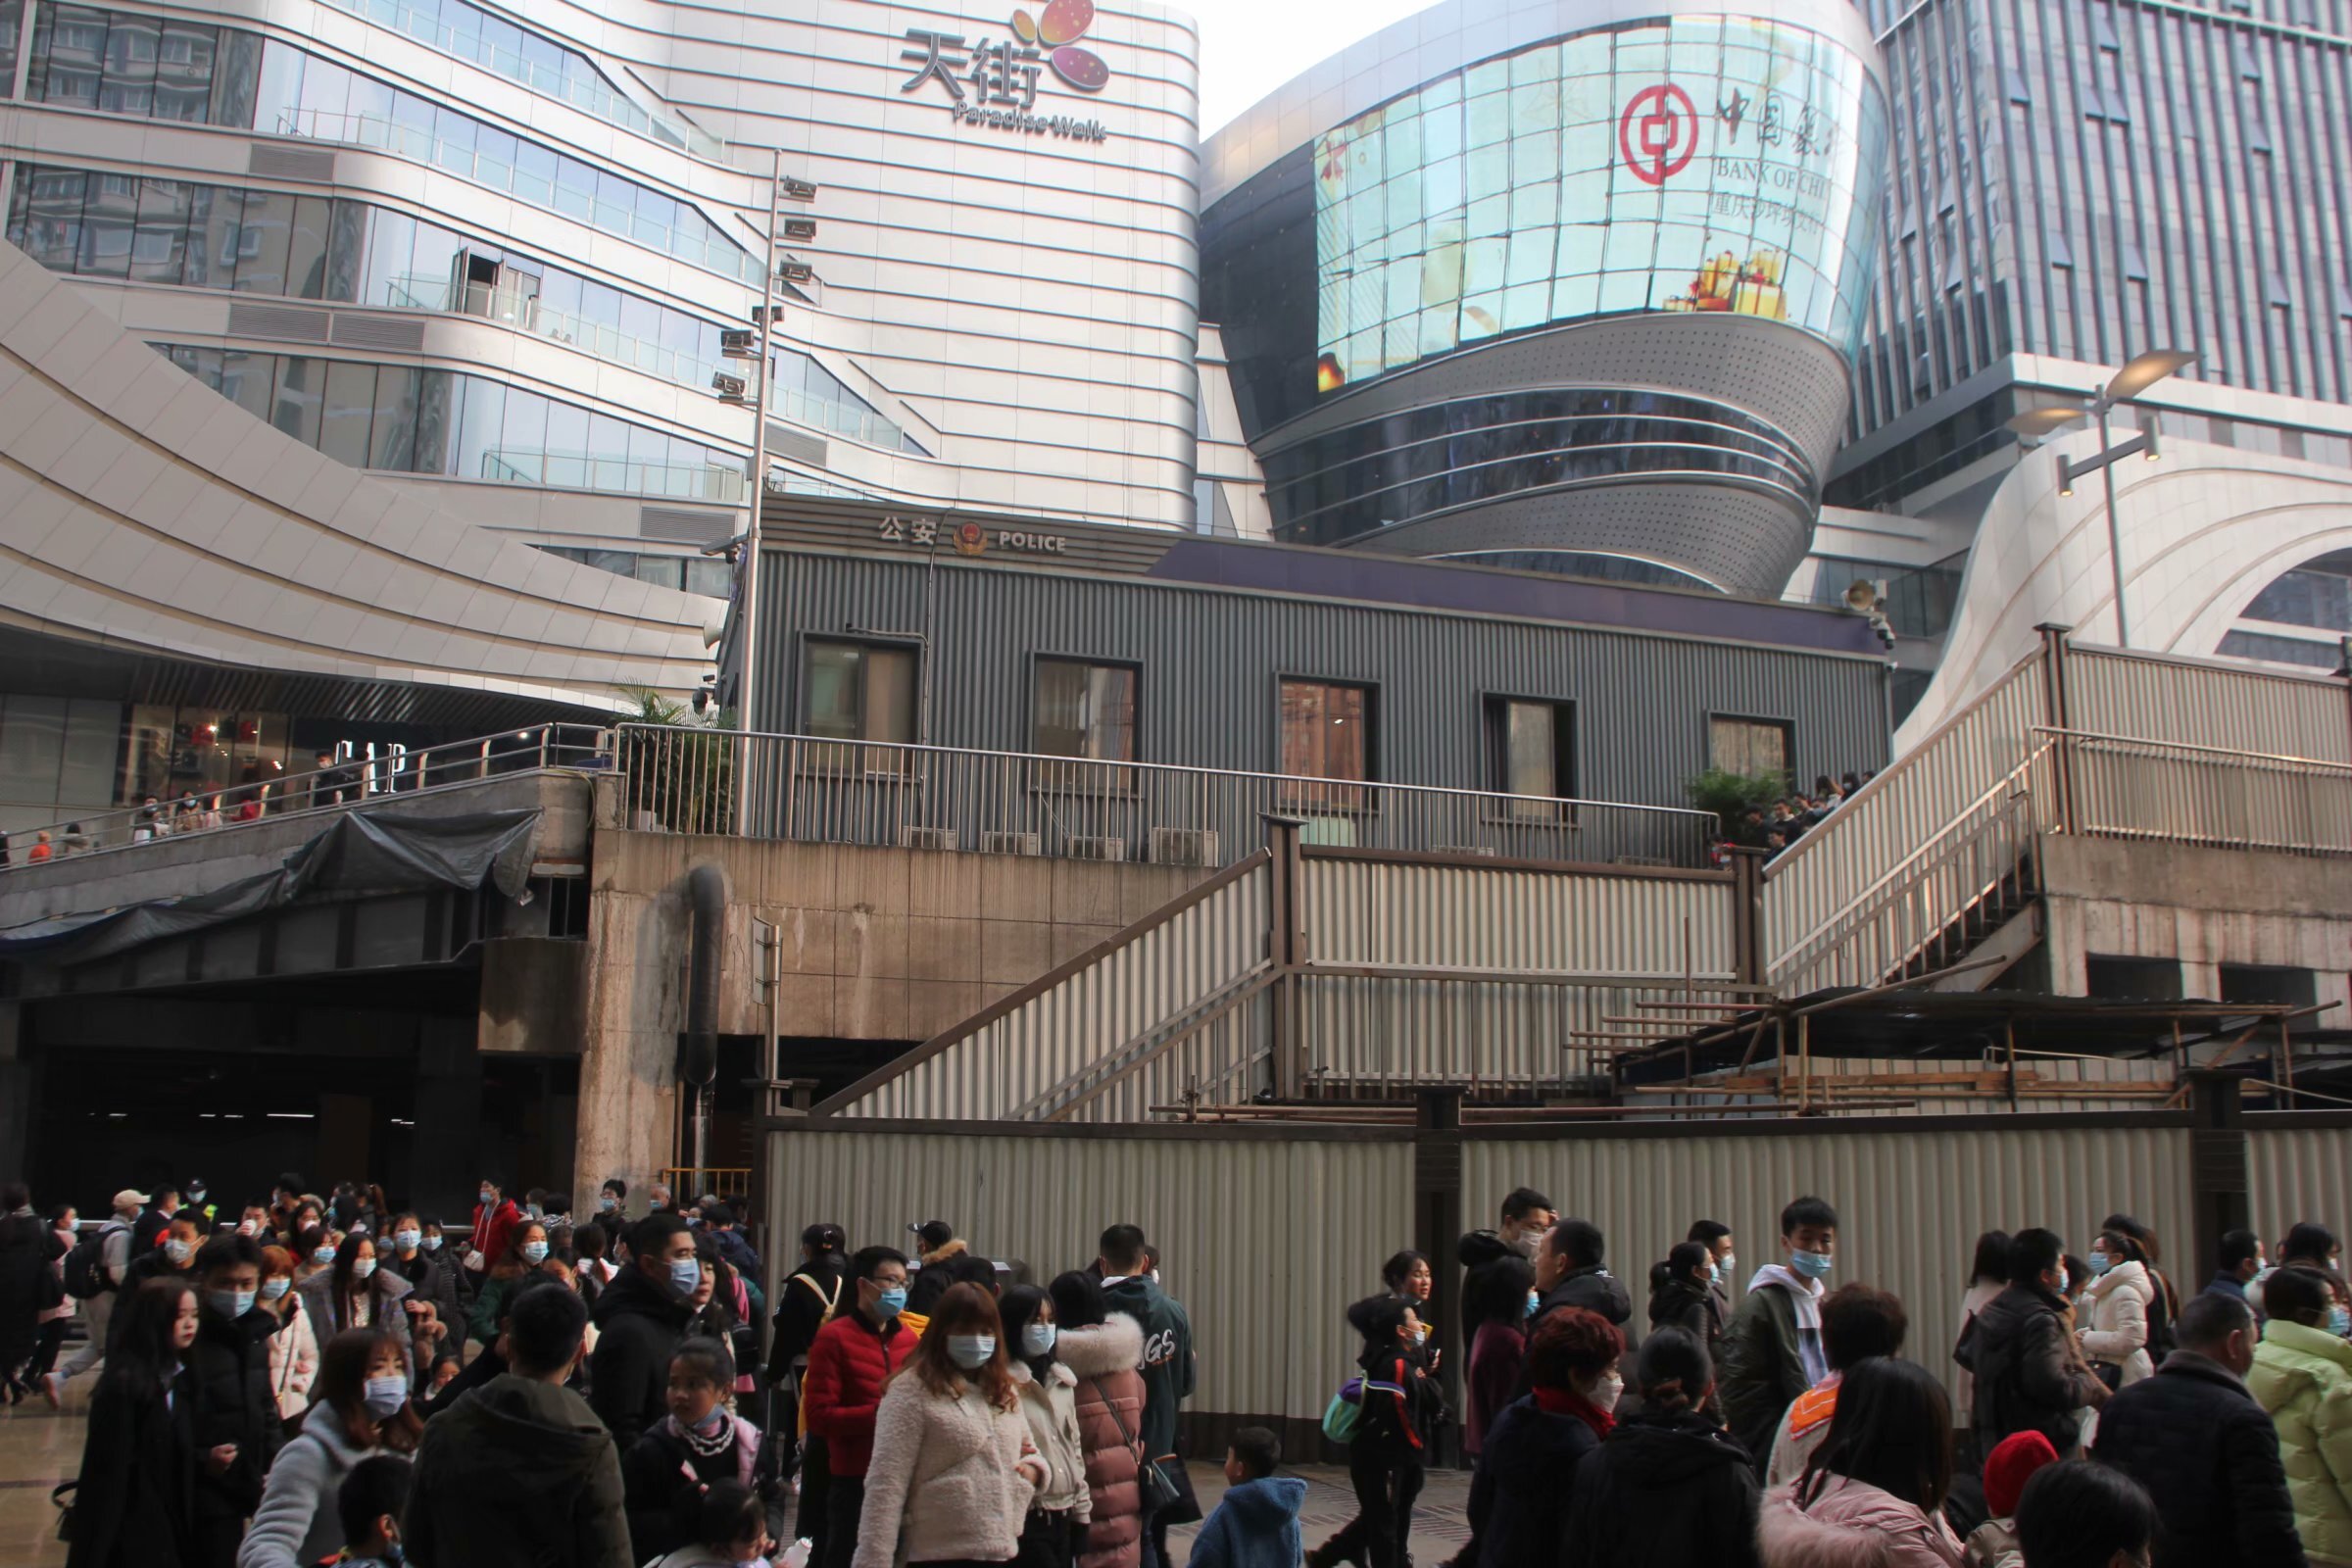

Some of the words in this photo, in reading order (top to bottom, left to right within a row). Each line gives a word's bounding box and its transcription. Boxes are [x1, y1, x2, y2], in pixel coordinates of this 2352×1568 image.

[900, 27, 1043, 109] 天街
[954, 101, 1050, 132] Paradise
[1052, 115, 1107, 142] Walk
[1716, 158, 1769, 185] BANK
[1774, 169, 1797, 190] OF
[1798, 173, 1827, 199] CHI
[878, 515, 938, 546] 公安
[998, 530, 1067, 553] POLICE
